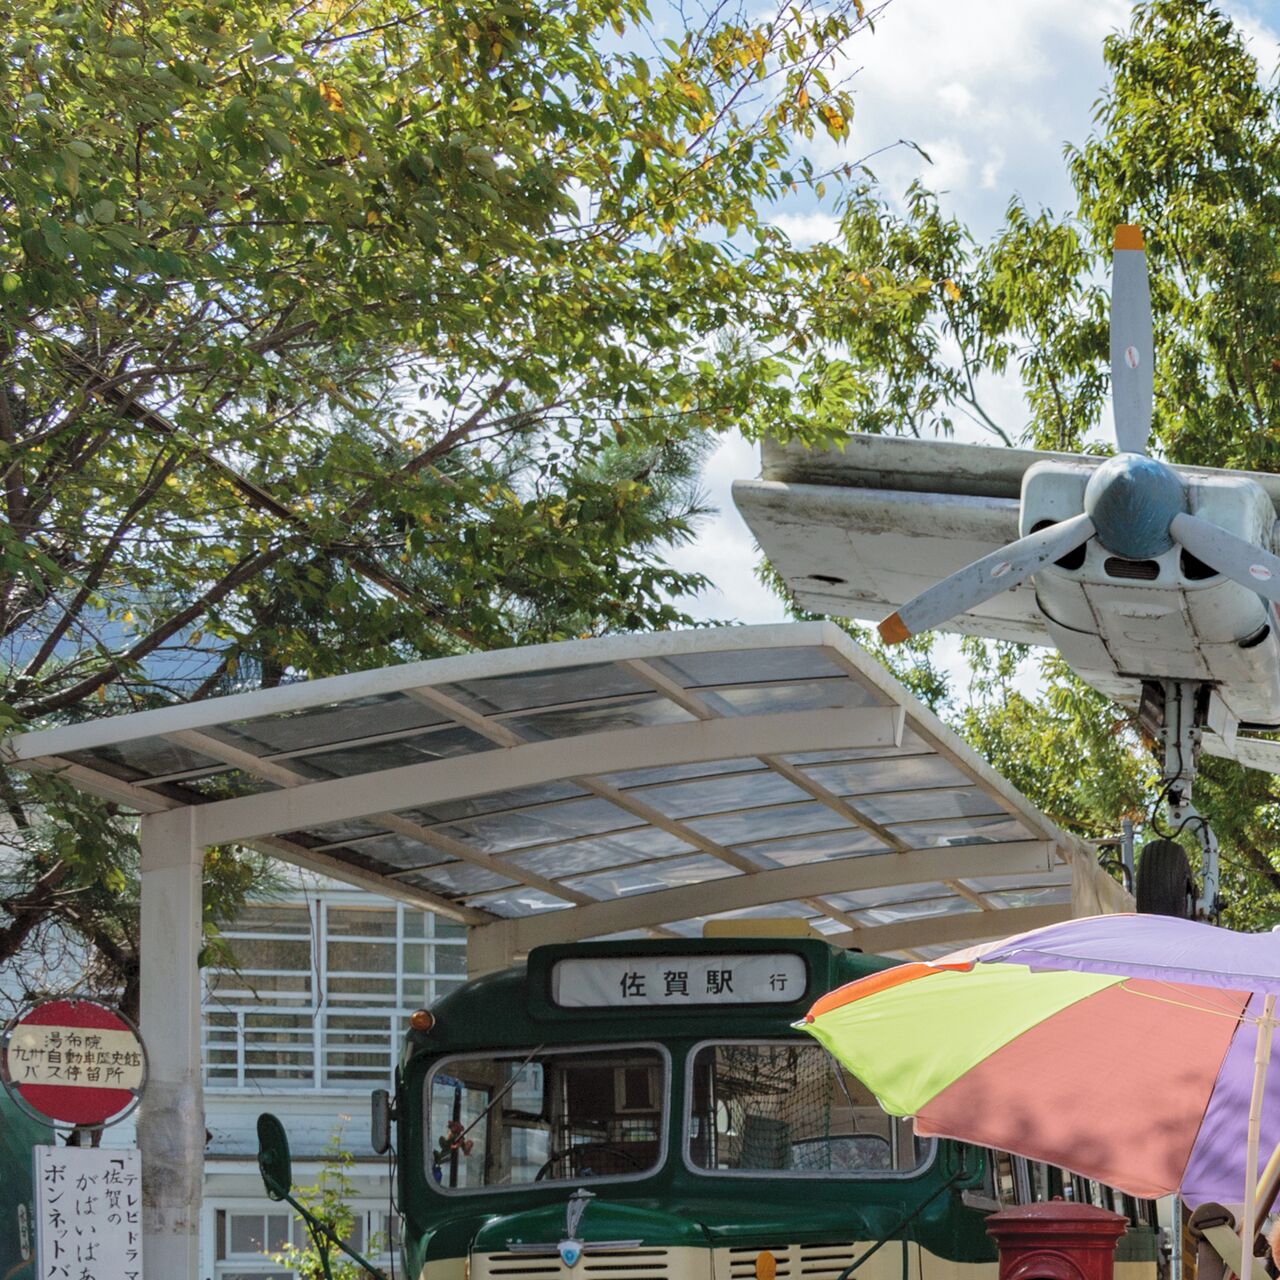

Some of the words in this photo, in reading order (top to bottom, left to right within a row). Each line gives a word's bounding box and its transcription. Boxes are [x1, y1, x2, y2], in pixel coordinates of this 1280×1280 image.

[620, 970, 735, 998] 佐賀駅
[769, 974, 788, 992] 行
[45, 1031, 103, 1050] 湯布院
[24, 1065, 126, 1084] バス停留所
